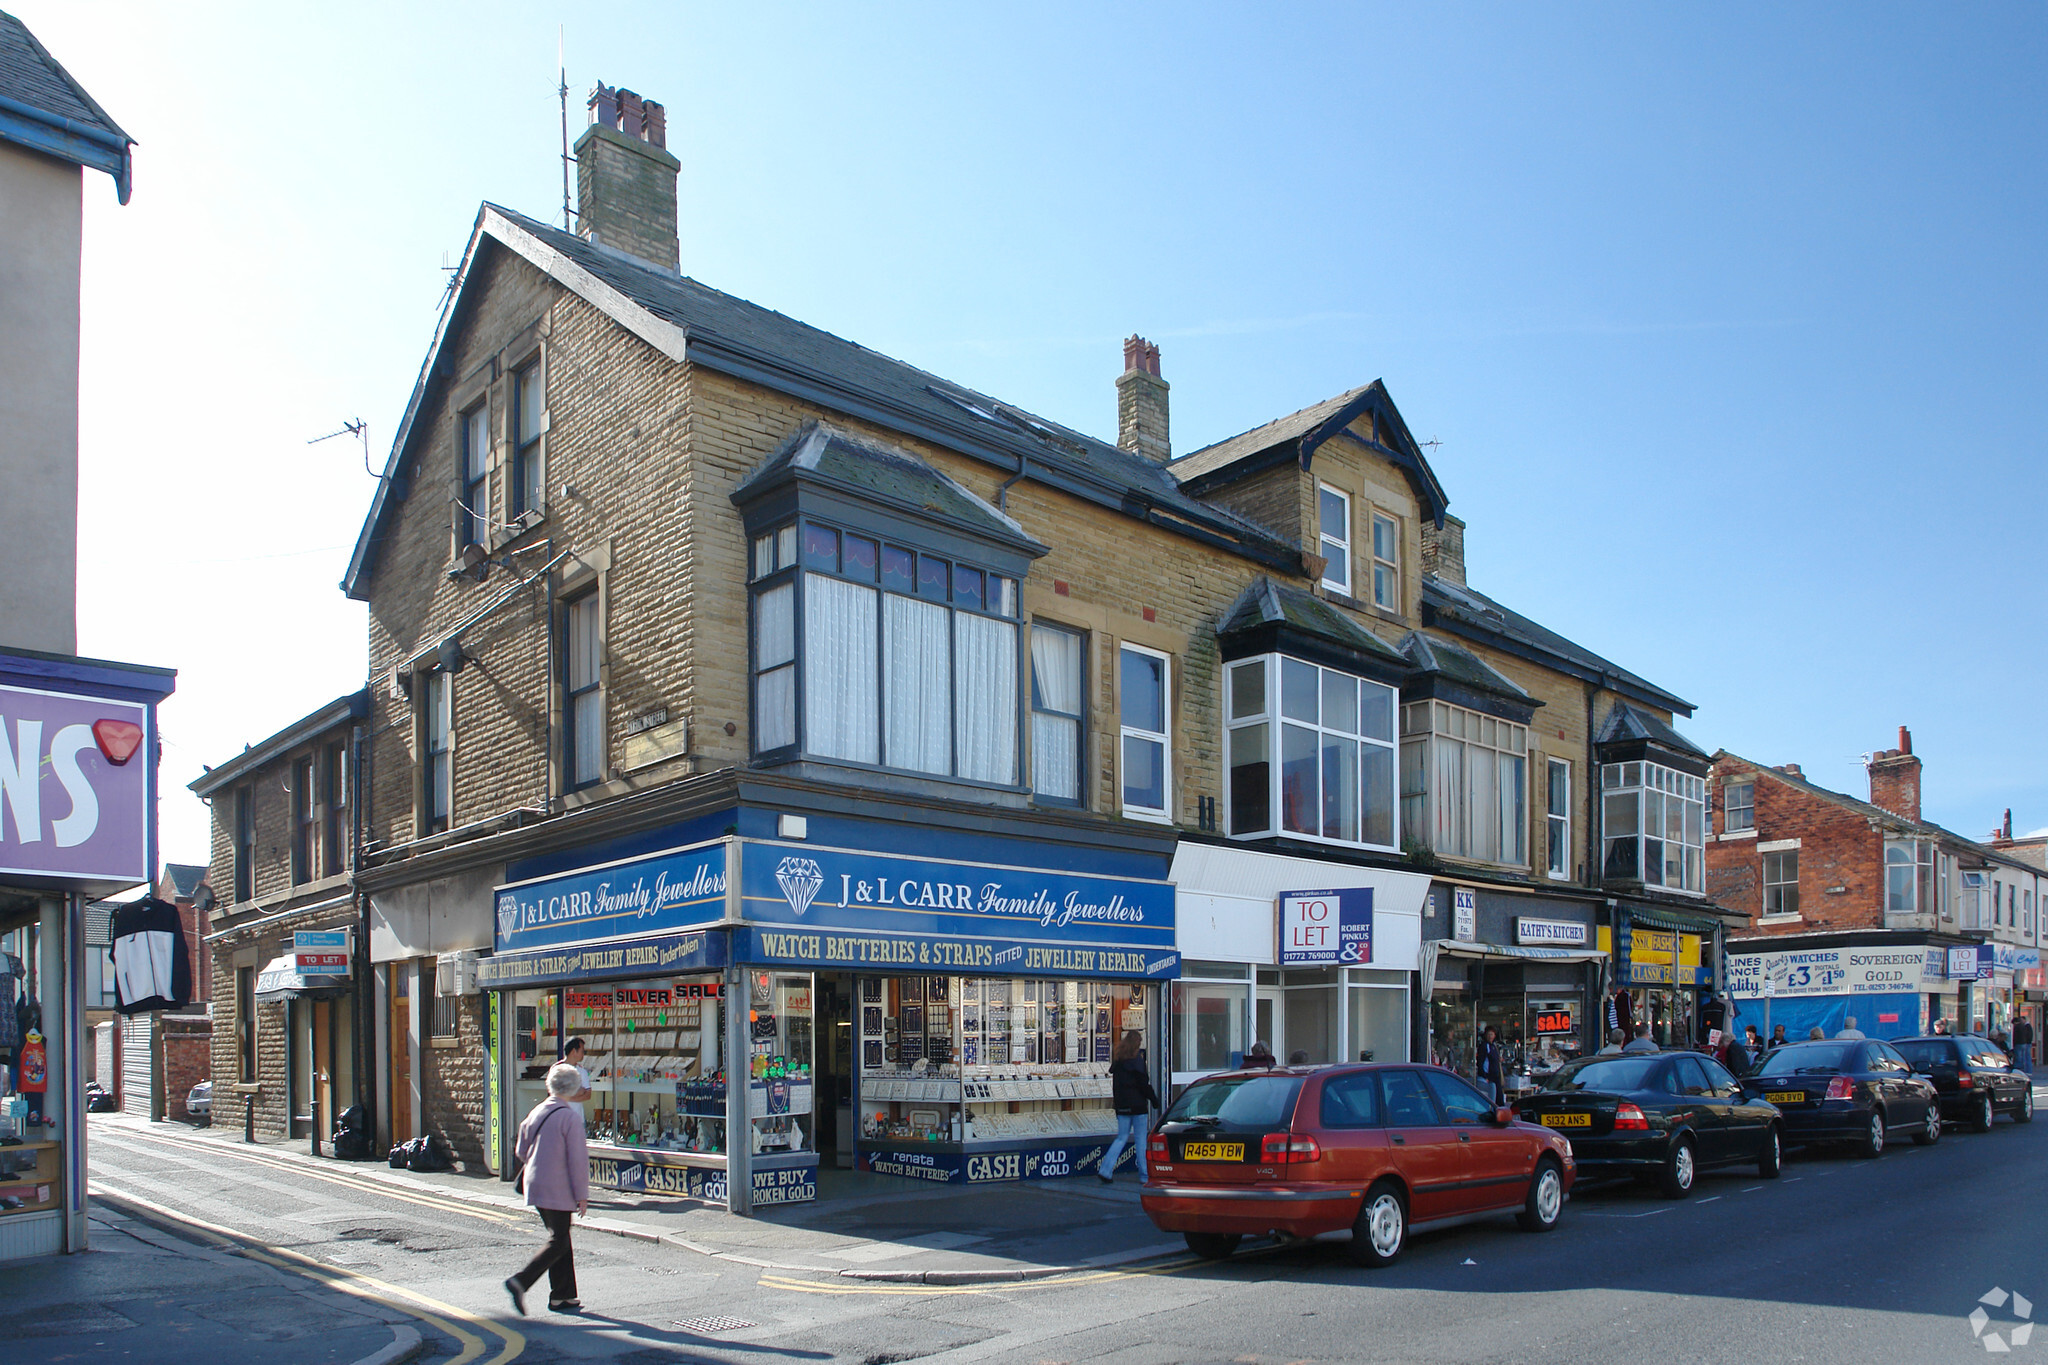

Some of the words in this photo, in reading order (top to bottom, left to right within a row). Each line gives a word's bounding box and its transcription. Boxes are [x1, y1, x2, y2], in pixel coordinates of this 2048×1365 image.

[519, 903, 526, 932] J
[528, 908, 536, 923] &
[538, 900, 547, 922] L
[549, 891, 592, 920] CARR
[594, 877, 650, 918] Family
[650, 864, 727, 916] Jewellers
[837, 874, 851, 908] J
[855, 880, 873, 903] &
[877, 877, 895, 904] L
[899, 880, 973, 911] CARR
[978, 882, 1057, 927] Family
[1057, 890, 1144, 927] Jewellers
[1457, 892, 1473, 908] KK
[1297, 900, 1328, 921] TO
[1341, 924, 1370, 932] ROBERT
[1520, 923, 1551, 938] KATHY'S
[1553, 925, 1584, 940] KITCHEN
[1294, 926, 1330, 947] LET
[1342, 932, 1369, 940] PINKUS
[1631, 935, 1651, 949] ASSIC
[499, 959, 533, 979] BATTERIES
[533, 959, 539, 976] &
[540, 957, 567, 975] STRAPS
[581, 951, 623, 971] JEWELLERY
[626, 946, 659, 966] REPAIRS
[660, 937, 699, 966] Undertaken
[761, 933, 820, 959] WATCH
[825, 936, 916, 964] BATTERIES
[919, 942, 929, 964] &
[933, 943, 993, 966] STRAPS
[995, 945, 1022, 965] FITTED
[1025, 947, 1096, 971] JEWELLERY
[1099, 951, 1146, 973] REPAIRS
[1147, 955, 1176, 975] UNDERTAKEN
[1284, 952, 1305, 960] 01772
[1308, 952, 1336, 960] 769000
[1340, 942, 1364, 961] &
[1955, 949, 1971, 959] TO
[1766, 955, 1788, 971] Quartz
[1789, 953, 1839, 963] WATCHES
[1850, 954, 1923, 966] SOVEREIGN
[1953, 961, 1971, 971] LET
[1632, 966, 1664, 981] CLASSIC
[1788, 966, 1811, 987] £3
[1822, 970, 1845, 985] £1.50
[1865, 971, 1903, 981] GOLD
[676, 985, 725, 999] SALE
[1731, 977, 1762, 997] ality
[566, 994, 585, 1006] HALF
[587, 994, 613, 1007] PRICE
[617, 990, 669, 1006] SILVER
[1537, 1012, 1570, 1031] sale
[1765, 1093, 1785, 1102] PG06
[1546, 1115, 1565, 1125] S132
[1568, 1115, 1585, 1124] ANS
[1044, 1150, 1066, 1163] OLD
[1187, 1144, 1216, 1157] R469
[1219, 1144, 1243, 1157] YBW
[893, 1152, 934, 1166] renata
[1076, 1146, 1101, 1171] CHAINS
[588, 1157, 618, 1186] ERIES
[621, 1163, 642, 1187] FITTED
[644, 1167, 688, 1193] CASH
[875, 1161, 903, 1175] WATCH
[905, 1165, 950, 1181] BATTERIES
[967, 1155, 1019, 1180] CASH
[1025, 1155, 1040, 1178] for
[1041, 1163, 1070, 1177] GOLD
[690, 1173, 703, 1187] PAID
[711, 1171, 727, 1183] OLD
[753, 1173, 775, 1187] WE
[779, 1169, 807, 1184] BUY
[691, 1184, 703, 1197] FOR
[705, 1182, 727, 1199] GOL
[753, 1186, 786, 1203] ROKEN
[788, 1184, 815, 1200] GOLD
